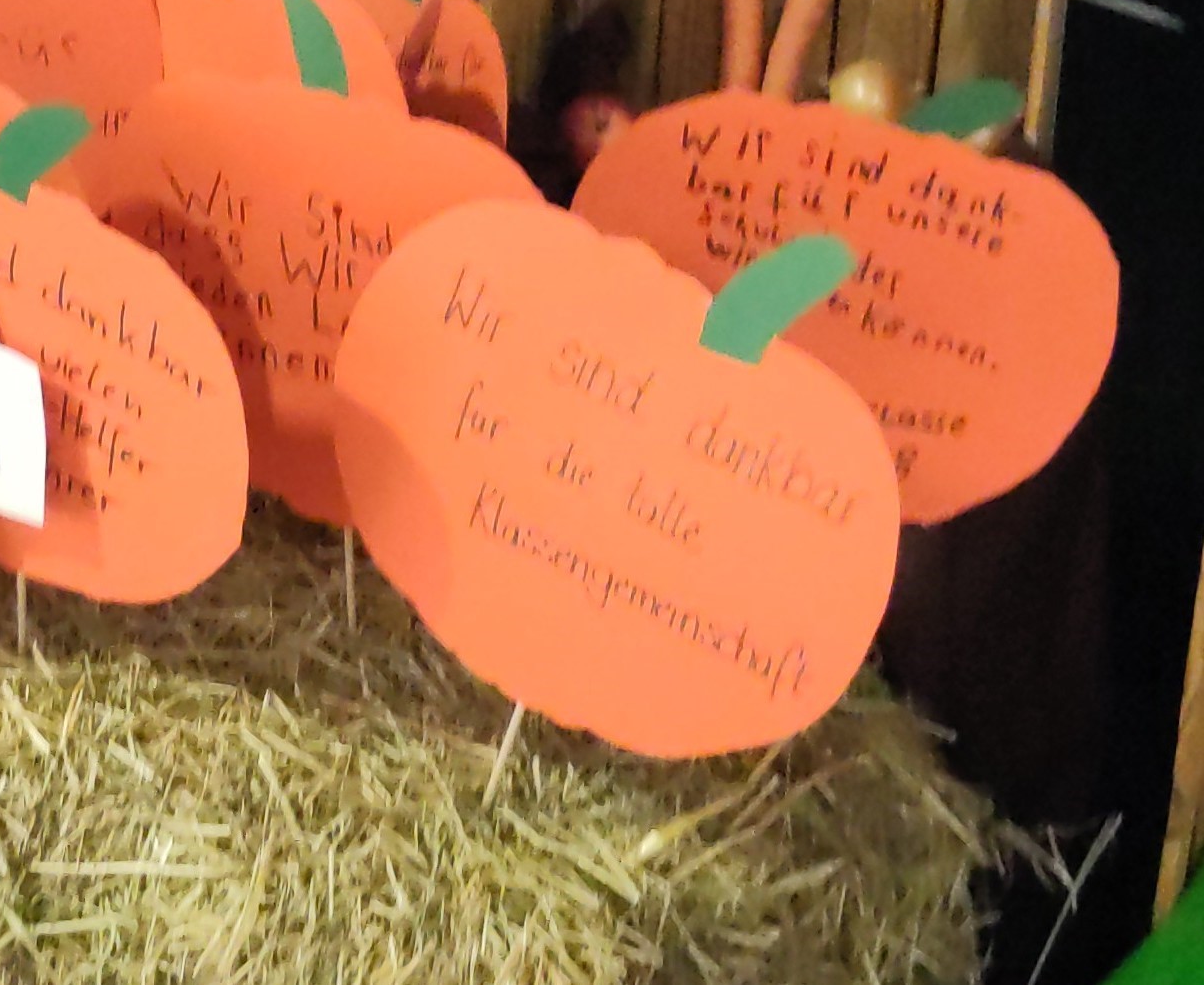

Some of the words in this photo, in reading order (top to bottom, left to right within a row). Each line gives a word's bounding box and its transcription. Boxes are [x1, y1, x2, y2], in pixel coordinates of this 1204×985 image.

[682, 122, 772, 163] Wir
[799, 137, 888, 184] sind
[161, 162, 250, 226] Wir
[280, 231, 358, 292] Wir
[887, 203, 1004, 257] unsere
[444, 267, 511, 343] Wir
[550, 338, 655, 415] sind
[685, 403, 862, 526] dankbar
[546, 442, 594, 486] die
[625, 470, 703, 547] tolle
[468, 480, 810, 702] Klassengemeinschaft
